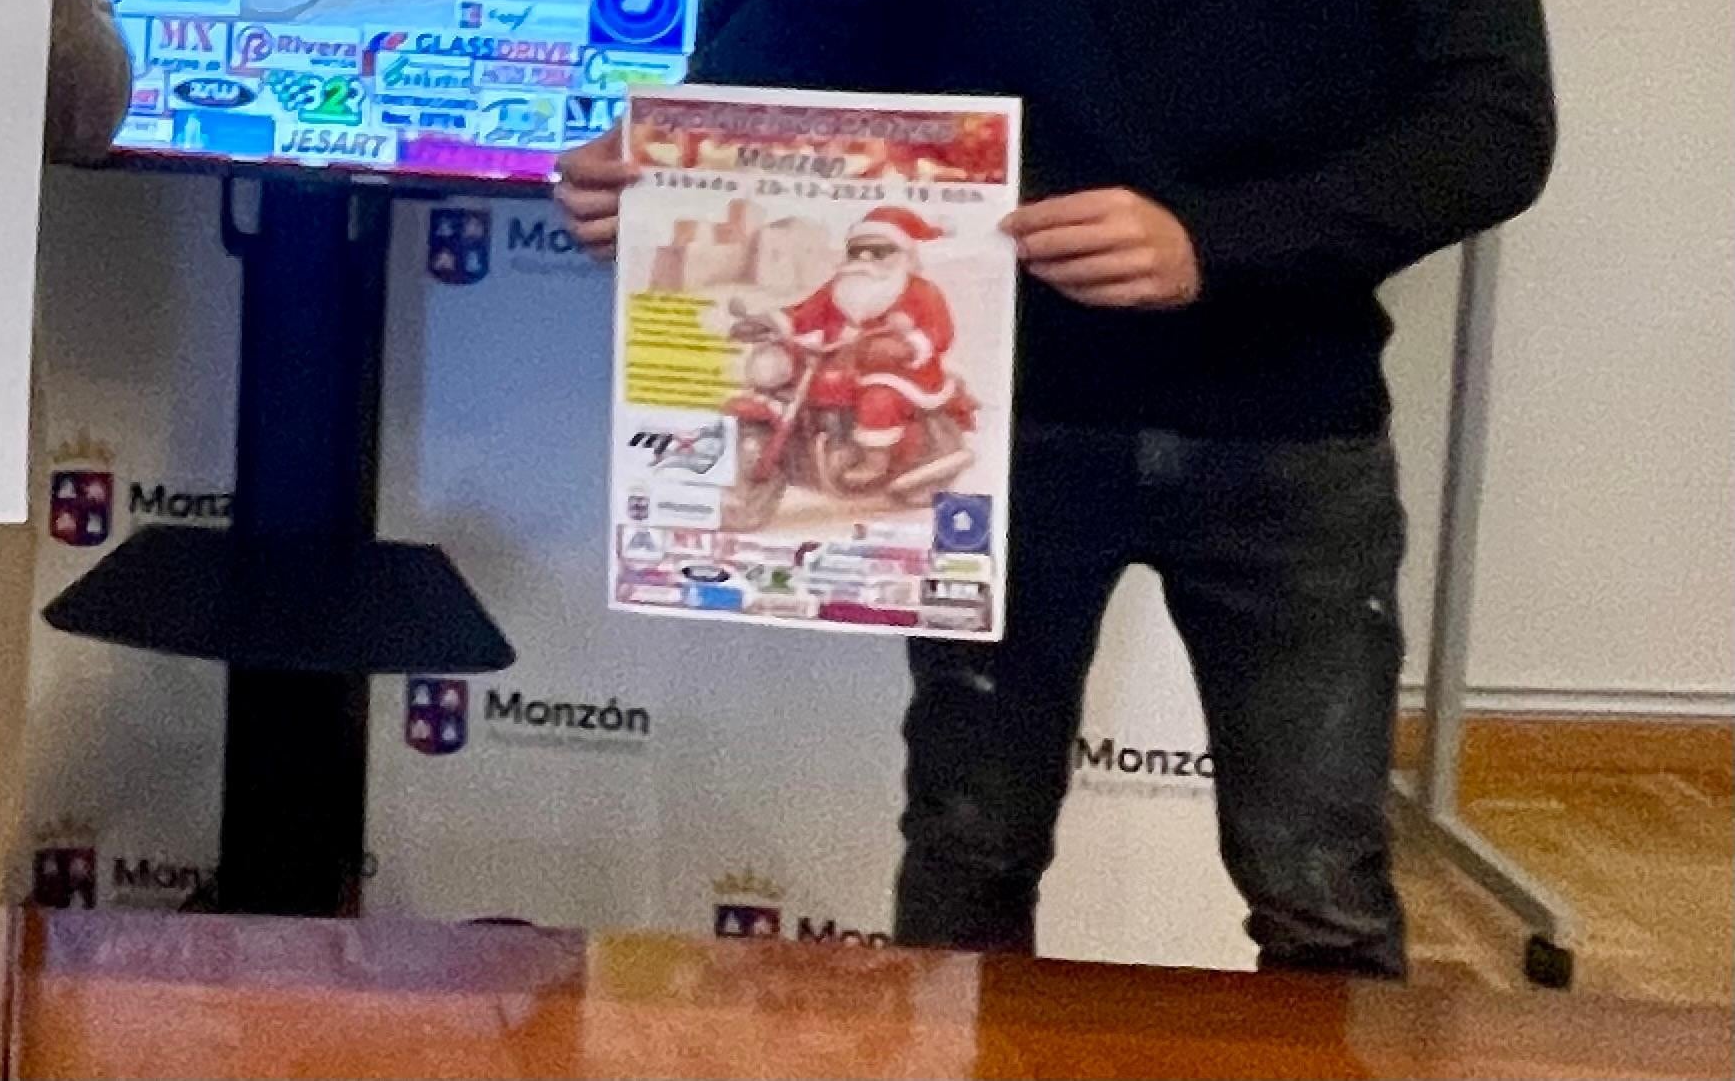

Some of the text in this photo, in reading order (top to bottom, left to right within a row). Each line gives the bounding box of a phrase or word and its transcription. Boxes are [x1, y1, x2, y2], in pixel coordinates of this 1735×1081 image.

[281, 128, 387, 159] JESART
[129, 481, 233, 518] Monz
[484, 688, 652, 735] Monzón
[113, 857, 201, 890] Mon
